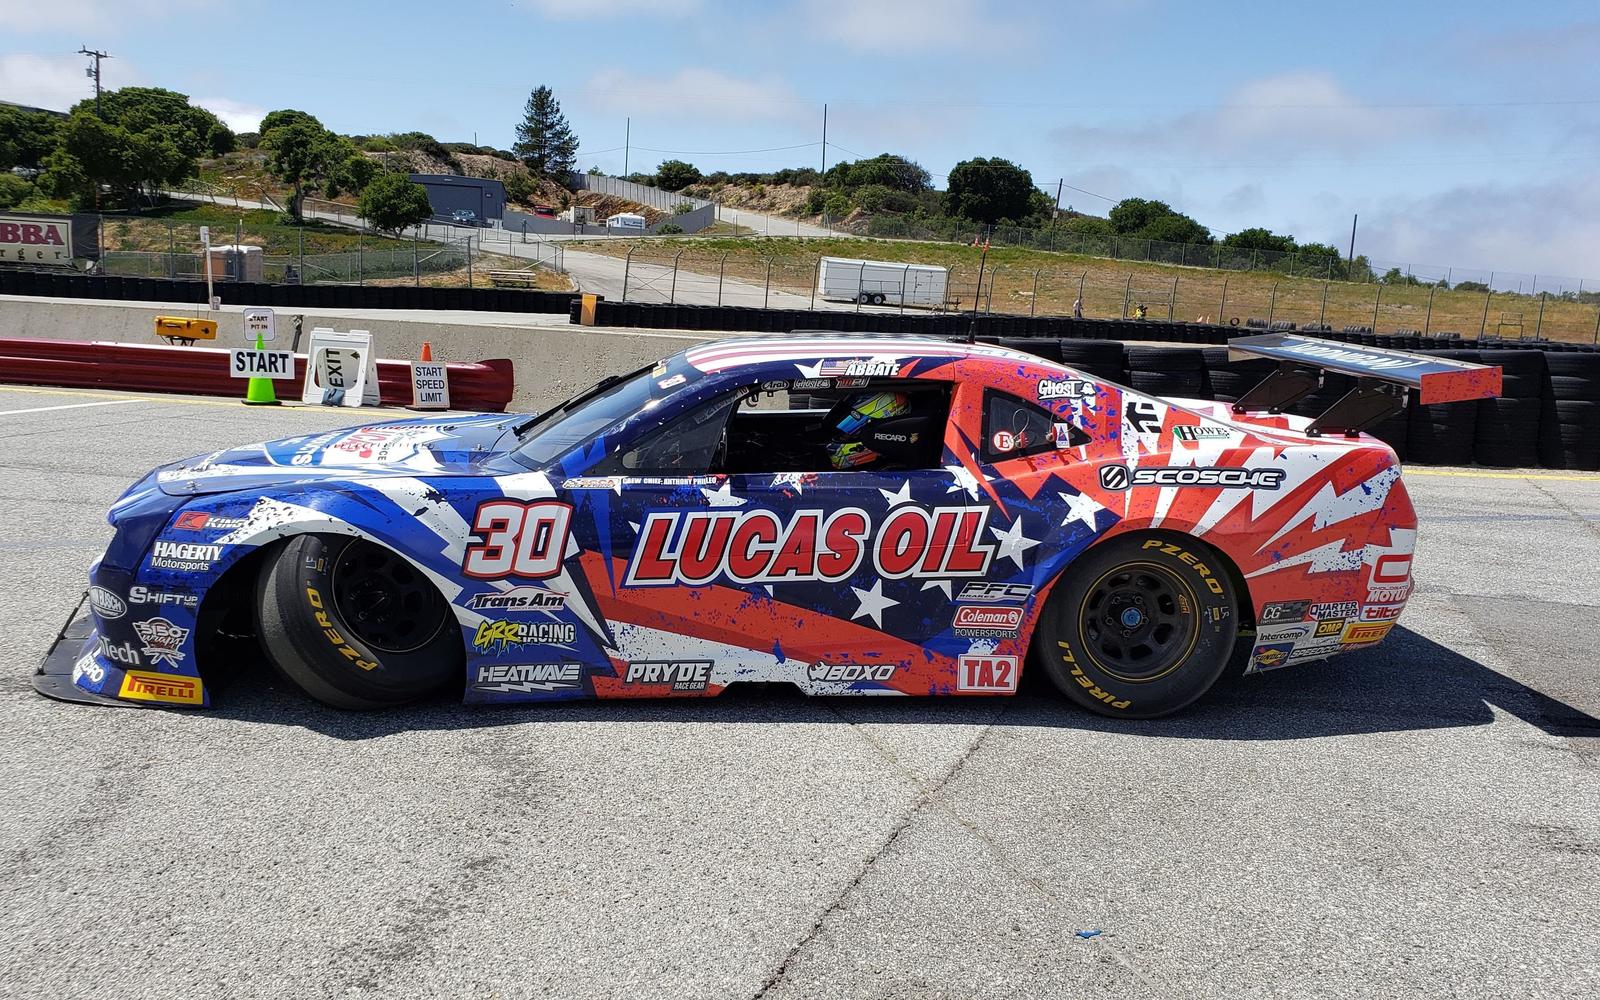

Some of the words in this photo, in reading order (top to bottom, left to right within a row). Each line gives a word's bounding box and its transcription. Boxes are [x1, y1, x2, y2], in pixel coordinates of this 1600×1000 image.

[236, 351, 289, 374] START
[326, 348, 345, 388] EXIT
[844, 363, 901, 376] ABBATE
[415, 366, 443, 377] START
[416, 379, 445, 390] SPEED
[1038, 380, 1082, 398] GHOST
[420, 391, 443, 403] LIMIT
[874, 433, 907, 442] RECARO
[1178, 425, 1224, 440] HOWE
[1132, 470, 1282, 487] SCOSCHE
[463, 500, 574, 578] 30
[628, 511, 869, 583] LUCAS
[875, 506, 991, 578] OIL
[153, 541, 223, 561] HAGERTY
[151, 556, 210, 571] Motorsports
[1141, 539, 1224, 595] PZERO
[962, 582, 1034, 597] PFC
[473, 593, 527, 608] Trans
[529, 592, 564, 607] Am
[960, 609, 1008, 623] Coleman
[1263, 606, 1282, 620] CG
[1310, 602, 1357, 615] QUARTER
[1317, 608, 1358, 620] MASTER
[140, 624, 182, 638] 5150
[306, 587, 378, 671] PZERO
[955, 628, 1018, 639] POWERSPORTS
[1318, 622, 1343, 634] OMP
[1260, 631, 1303, 641] Intercomp
[478, 664, 580, 682] HEATWAVE
[626, 662, 712, 683] PRYDE
[825, 665, 896, 680] BOXO
[963, 659, 1012, 688] TA2
[1057, 640, 1132, 709] PIRELLI
[128, 675, 196, 699] PIRELLI
[674, 682, 690, 690] RACE
[690, 682, 706, 690] GEAR
